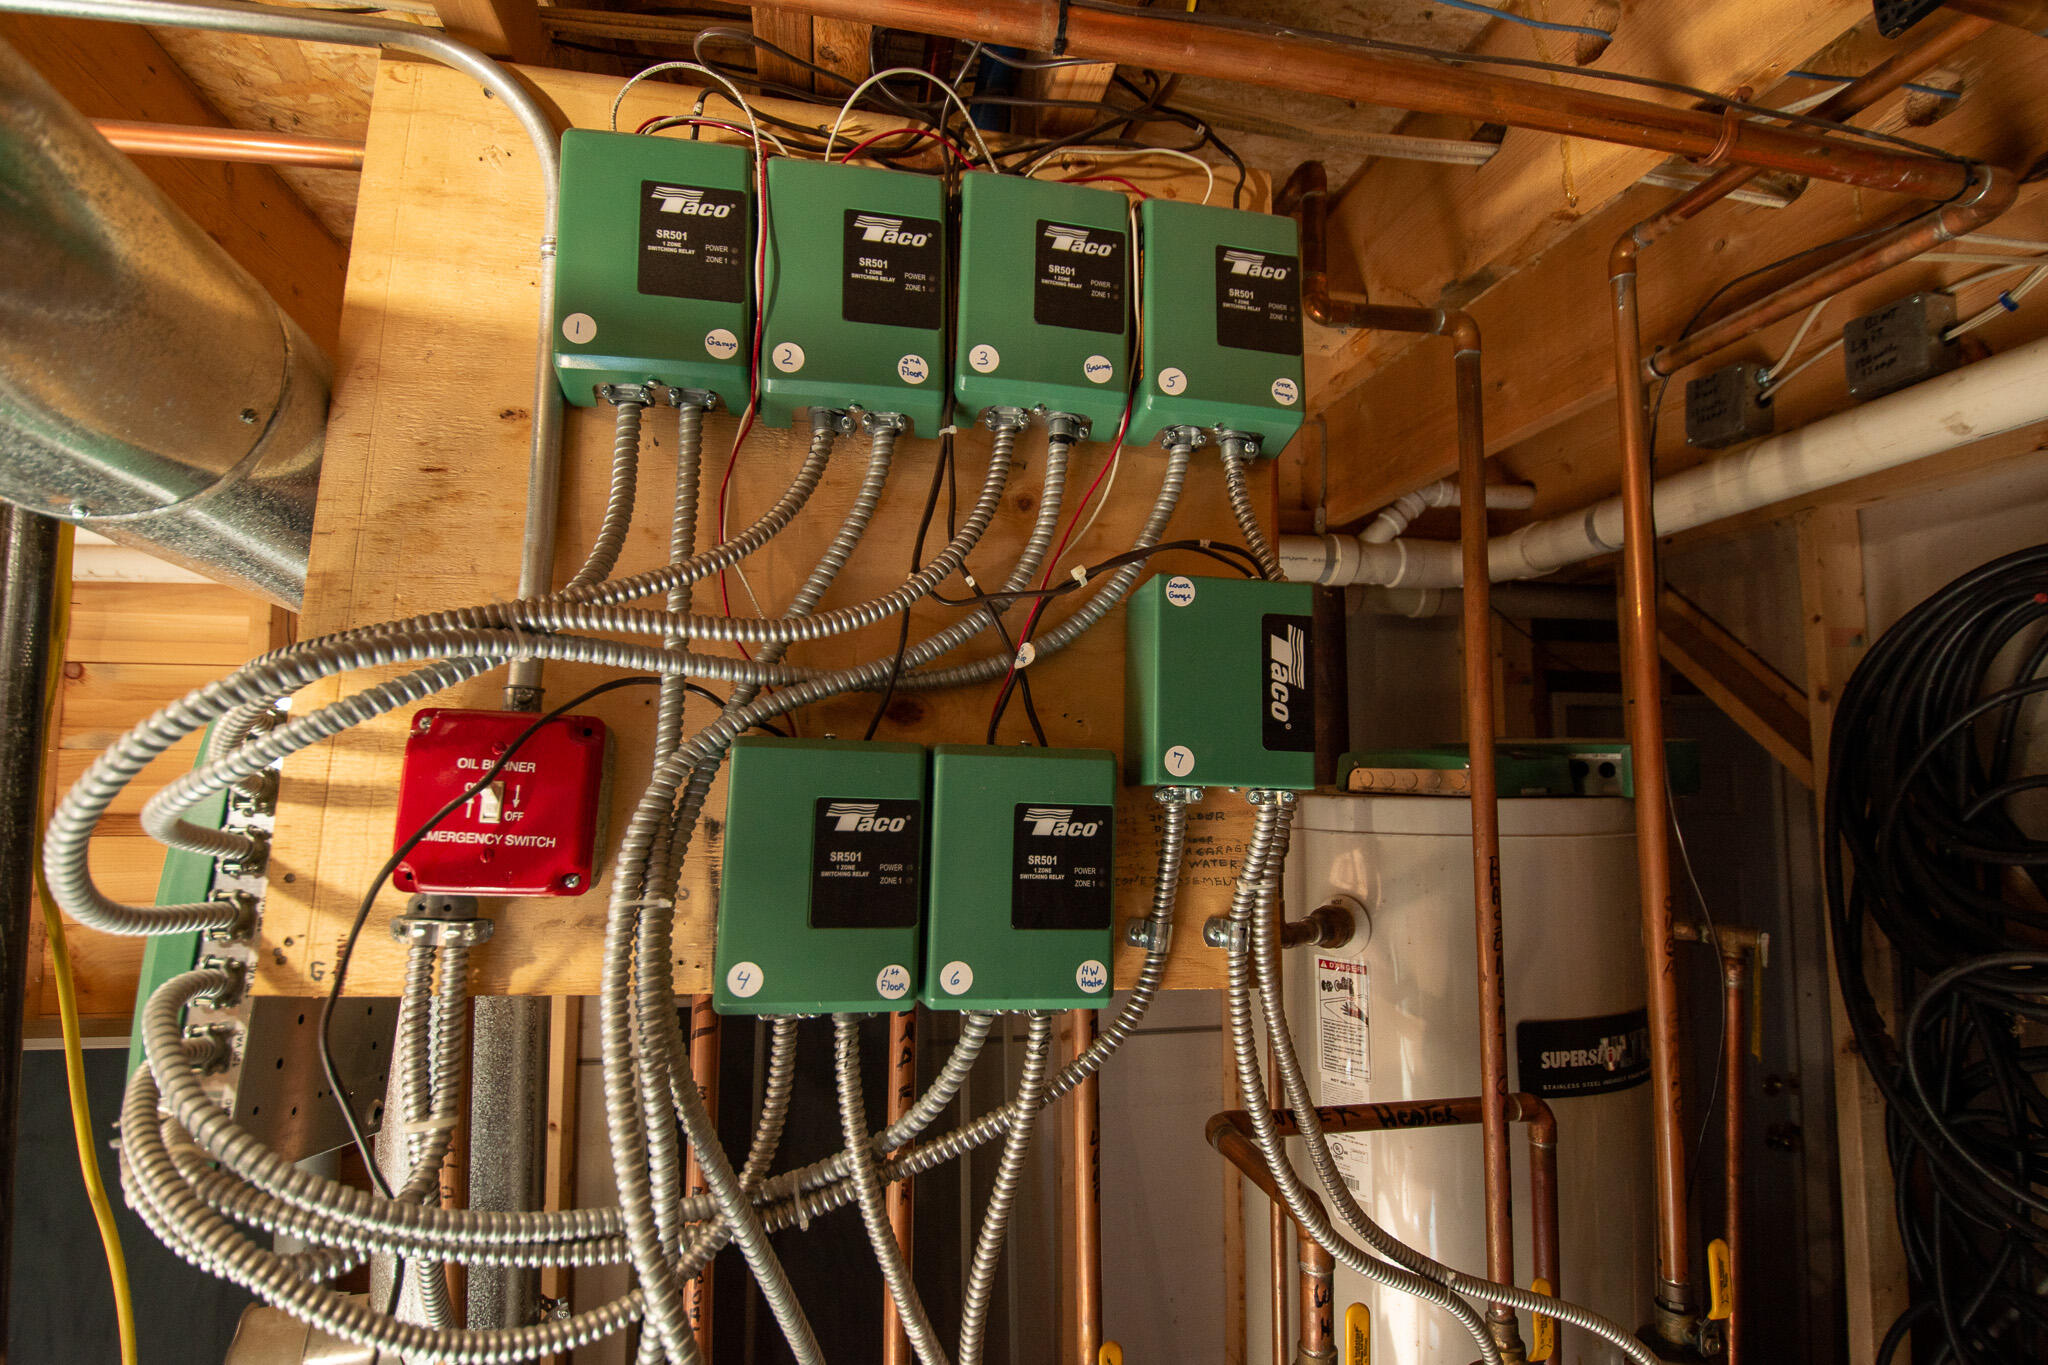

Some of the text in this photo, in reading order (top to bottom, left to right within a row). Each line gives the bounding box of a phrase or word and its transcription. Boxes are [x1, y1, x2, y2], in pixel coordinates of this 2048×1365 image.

[651, 186, 730, 218] Taco
[656, 229, 688, 241] SR501
[854, 215, 928, 247] Taco
[1044, 225, 1113, 257] Taco
[647, 245, 677, 253] SWITCHING
[705, 244, 729, 253] POWER
[706, 256, 723, 264] ZONE
[859, 257, 889, 269] SR501
[1048, 264, 1076, 276] SR501
[851, 273, 879, 281] SWITCHING
[904, 272, 926, 281] POWER
[905, 283, 921, 292] ZONE
[1041, 279, 1067, 287] SWITCHING
[1090, 280, 1111, 288] POWER
[1091, 290, 1106, 298] ZONE
[1229, 288, 1254, 300] SR501
[575, 321, 580, 335] 1
[782, 349, 794, 365] 2
[977, 351, 989, 365] 3
[1166, 375, 1180, 388] 5
[1271, 624, 1305, 722] Taco
[457, 757, 479, 770] OIL
[1173, 751, 1184, 769] 7
[504, 811, 524, 822] OFF
[825, 803, 906, 832] Taco
[1023, 808, 1098, 837] Taco
[505, 834, 556, 848] SWITCH
[830, 851, 862, 862] SR501
[1028, 854, 1057, 865] SR501
[880, 863, 903, 872] POWER
[1074, 867, 1096, 875] POWER
[880, 876, 897, 885] ZONE
[737, 971, 750, 990] 4
[950, 971, 960, 985] 6
